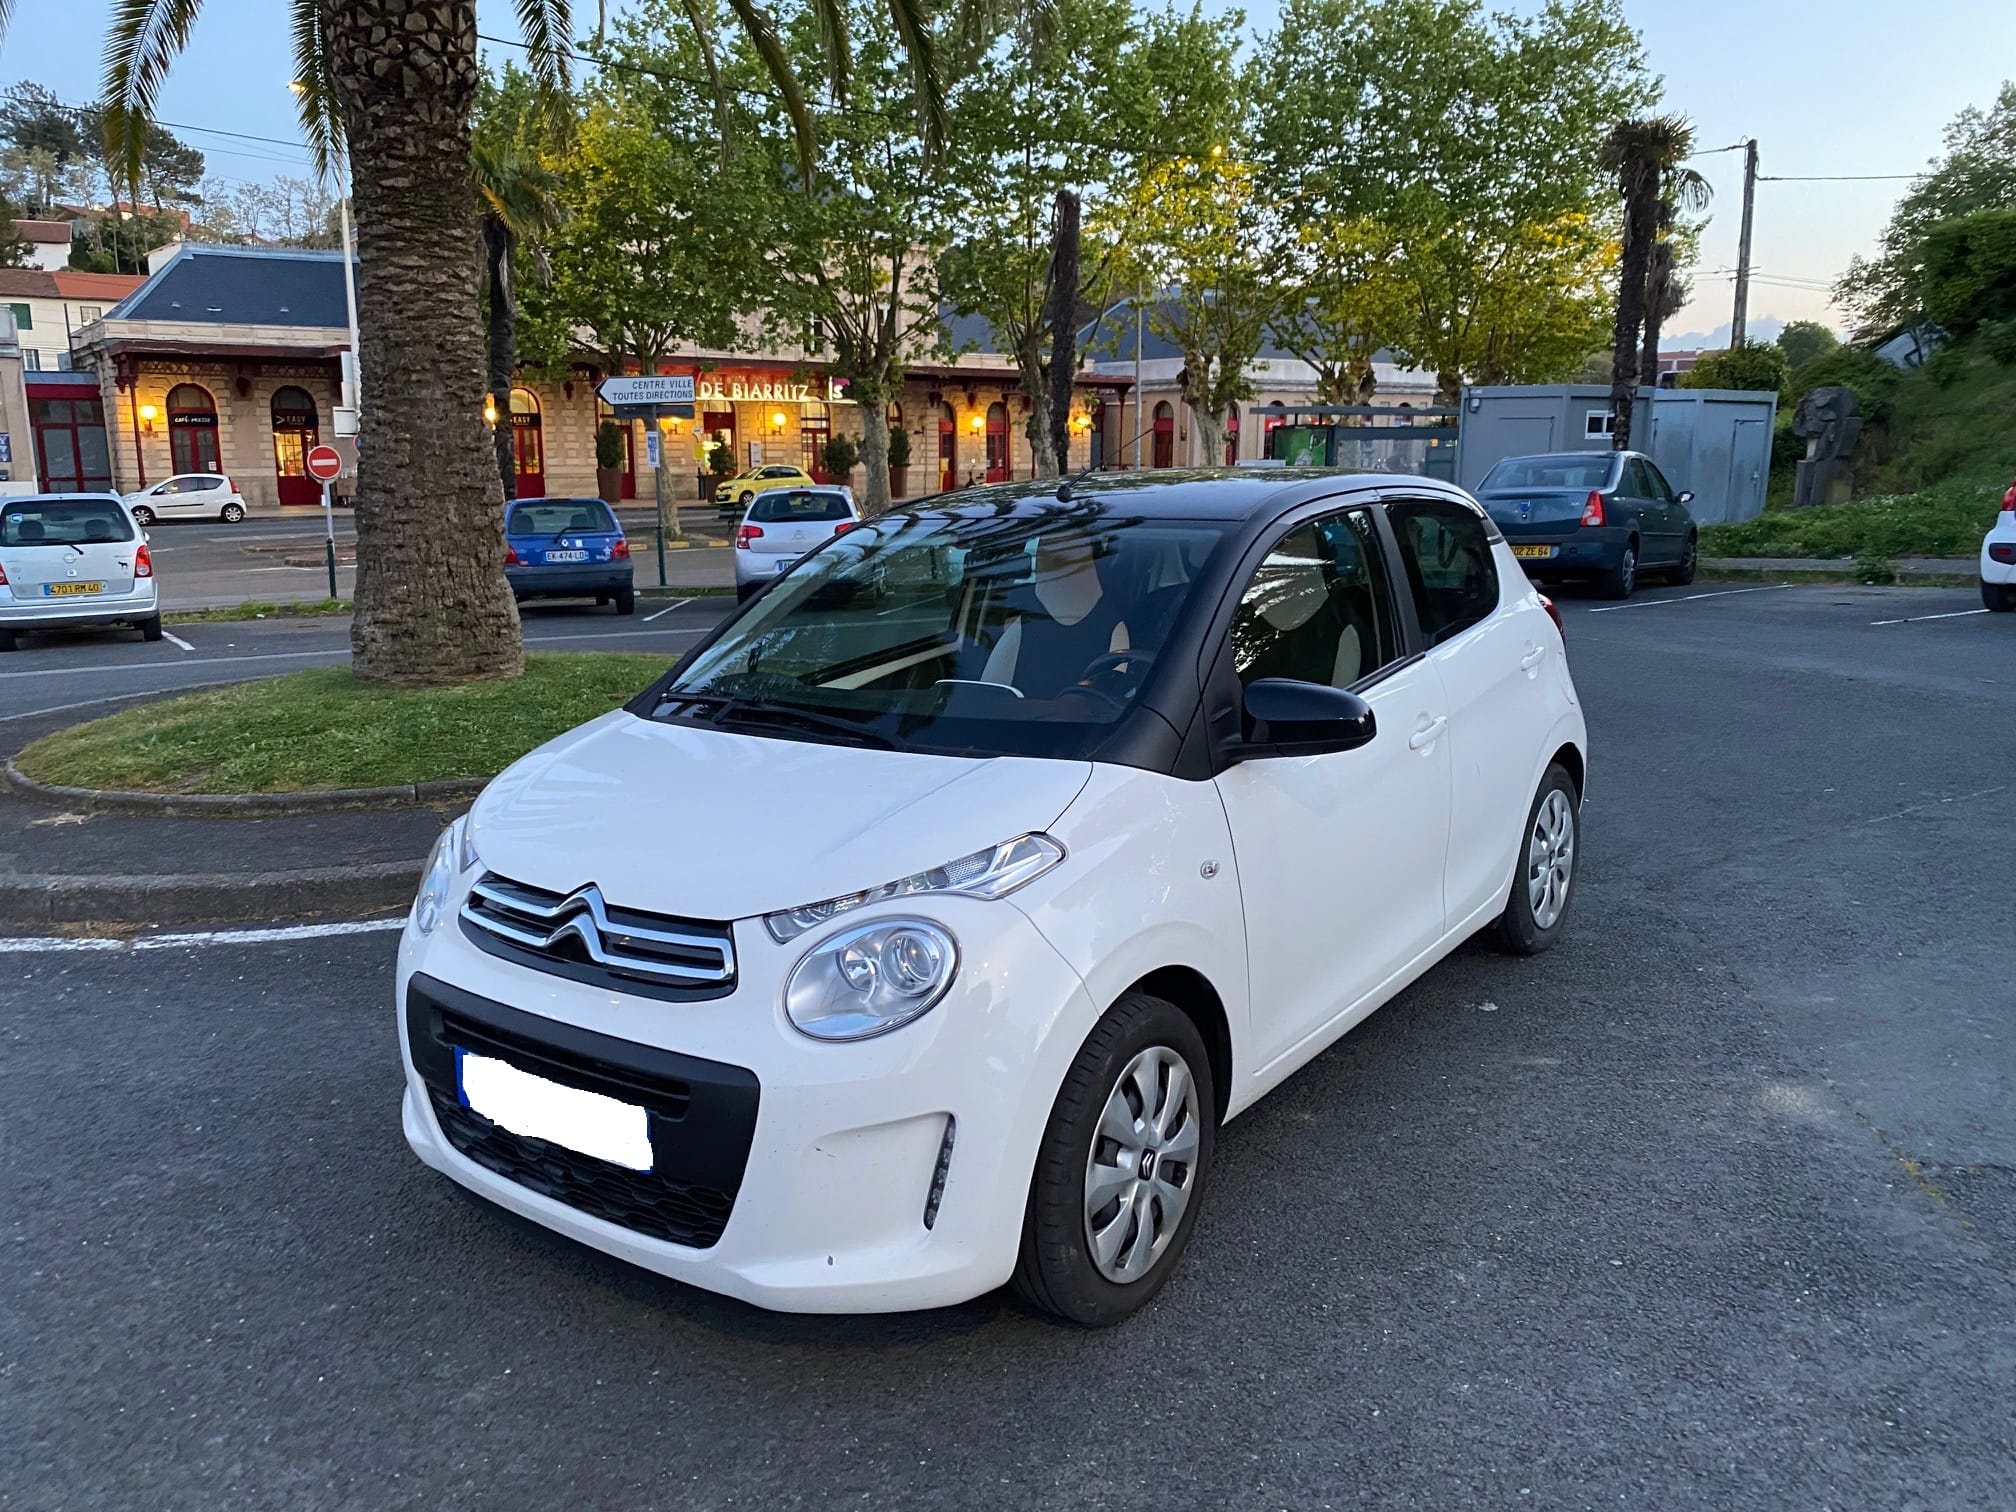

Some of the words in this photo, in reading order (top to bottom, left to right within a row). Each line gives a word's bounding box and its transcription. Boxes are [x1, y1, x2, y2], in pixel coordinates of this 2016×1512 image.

[632, 381, 665, 389] CENTRE
[669, 379, 692, 388] VILLE
[613, 391, 644, 401] TOUTES
[646, 390, 693, 400] DIRECTIONS
[701, 382, 723, 399] DE
[732, 382, 809, 401] BIARRITZ
[50, 585, 73, 594] 4701
[88, 583, 99, 592] 40
